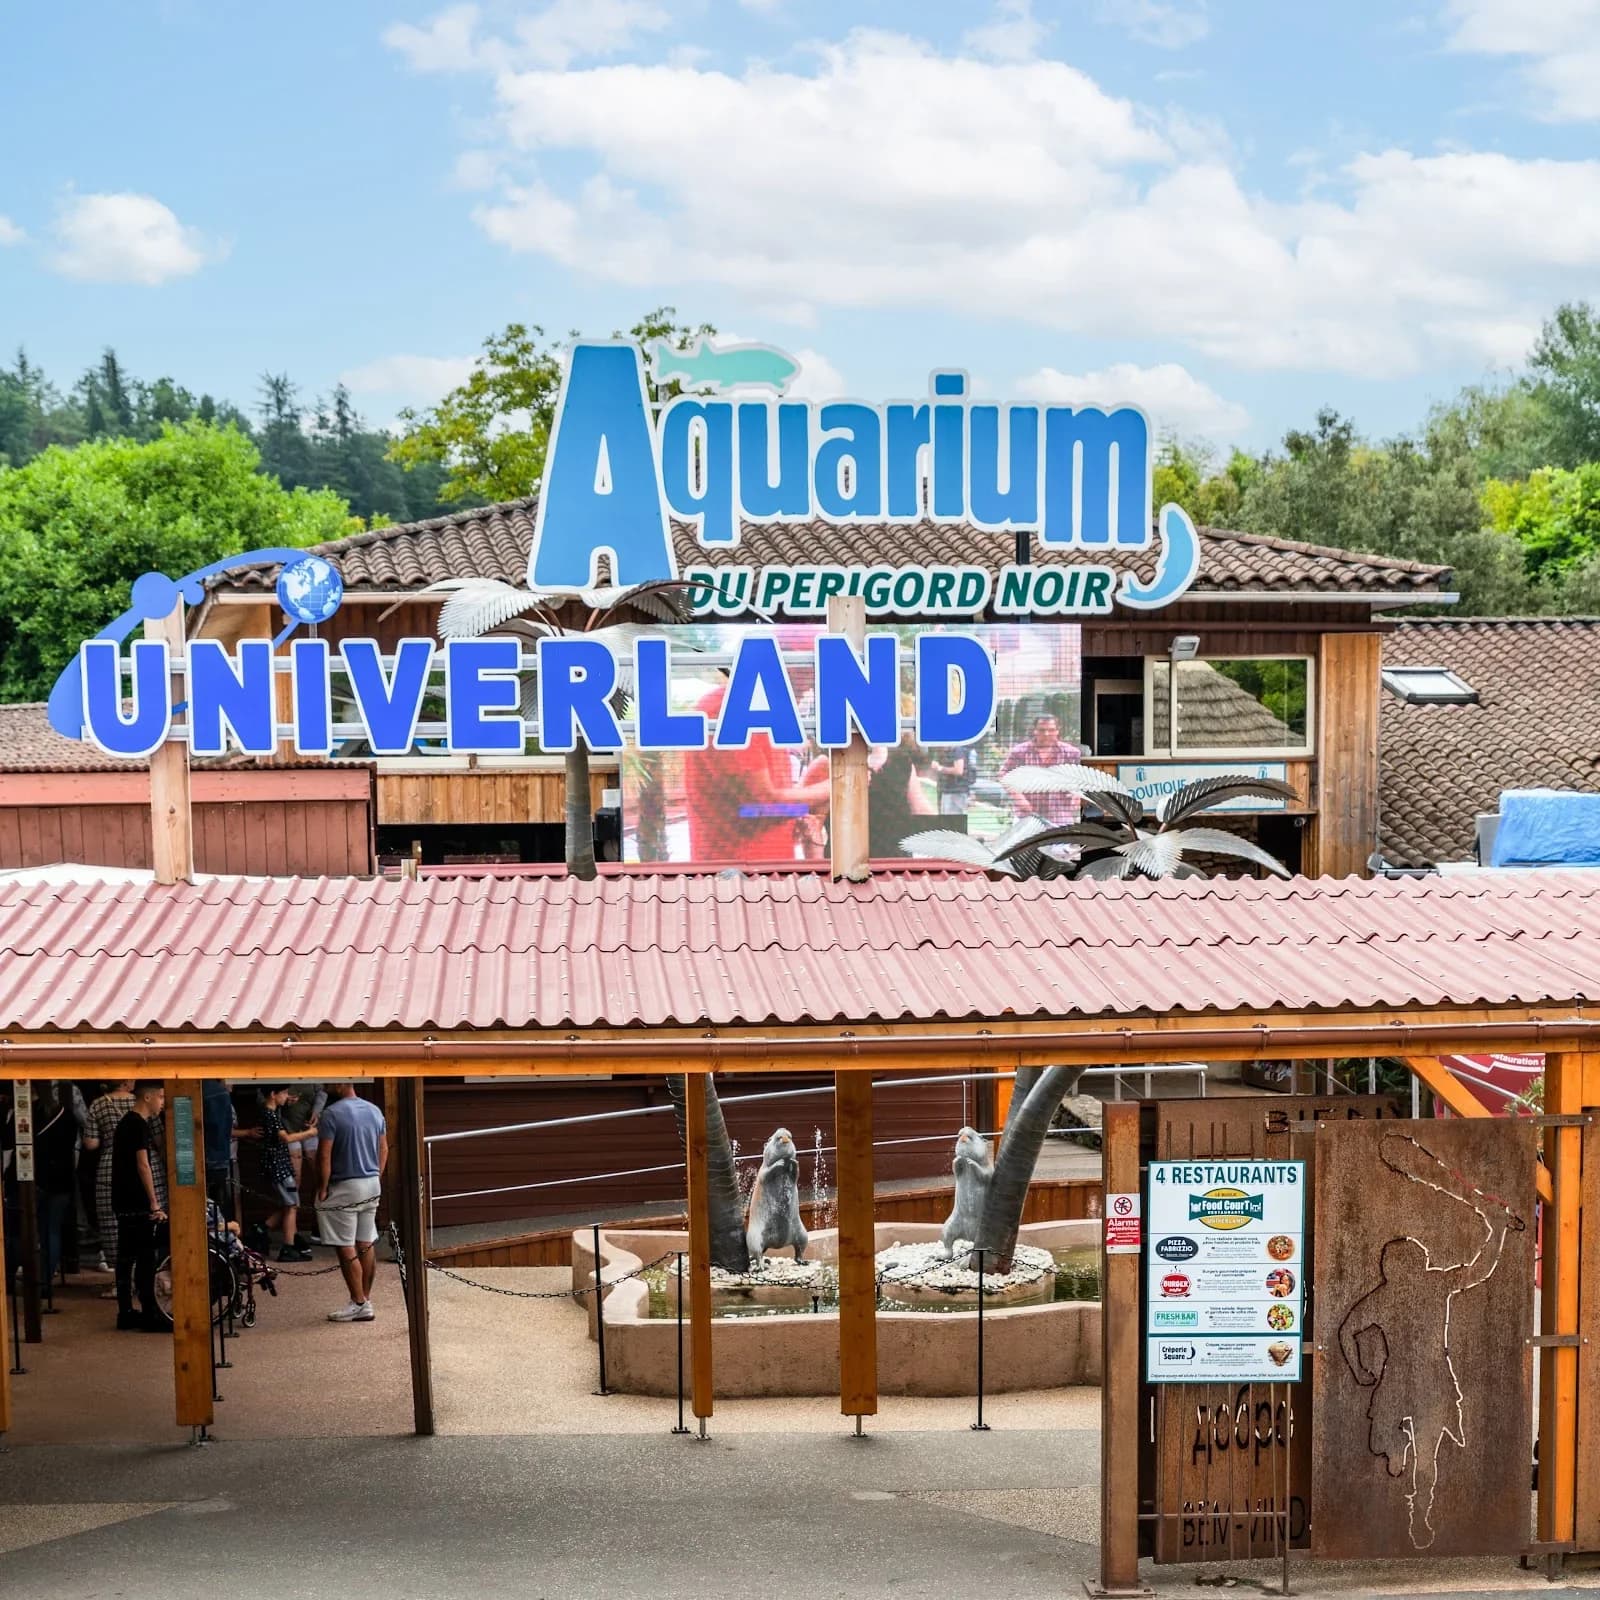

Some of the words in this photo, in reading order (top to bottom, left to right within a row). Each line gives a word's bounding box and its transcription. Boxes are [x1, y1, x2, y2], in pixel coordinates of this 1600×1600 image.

[530, 340, 1153, 592] Aquarium
[687, 572, 750, 610] DU
[761, 571, 986, 609] PERIGORD
[1000, 571, 1110, 607] NOIR
[80, 633, 998, 757] UNIVERLAND
[1155, 1167, 1166, 1184] 4
[1172, 1166, 1297, 1184] RESTAURANTS
[1202, 1200, 1223, 1211] Food
[1108, 1219, 1139, 1227] Alarme
[1163, 1353, 1186, 1361] Square
